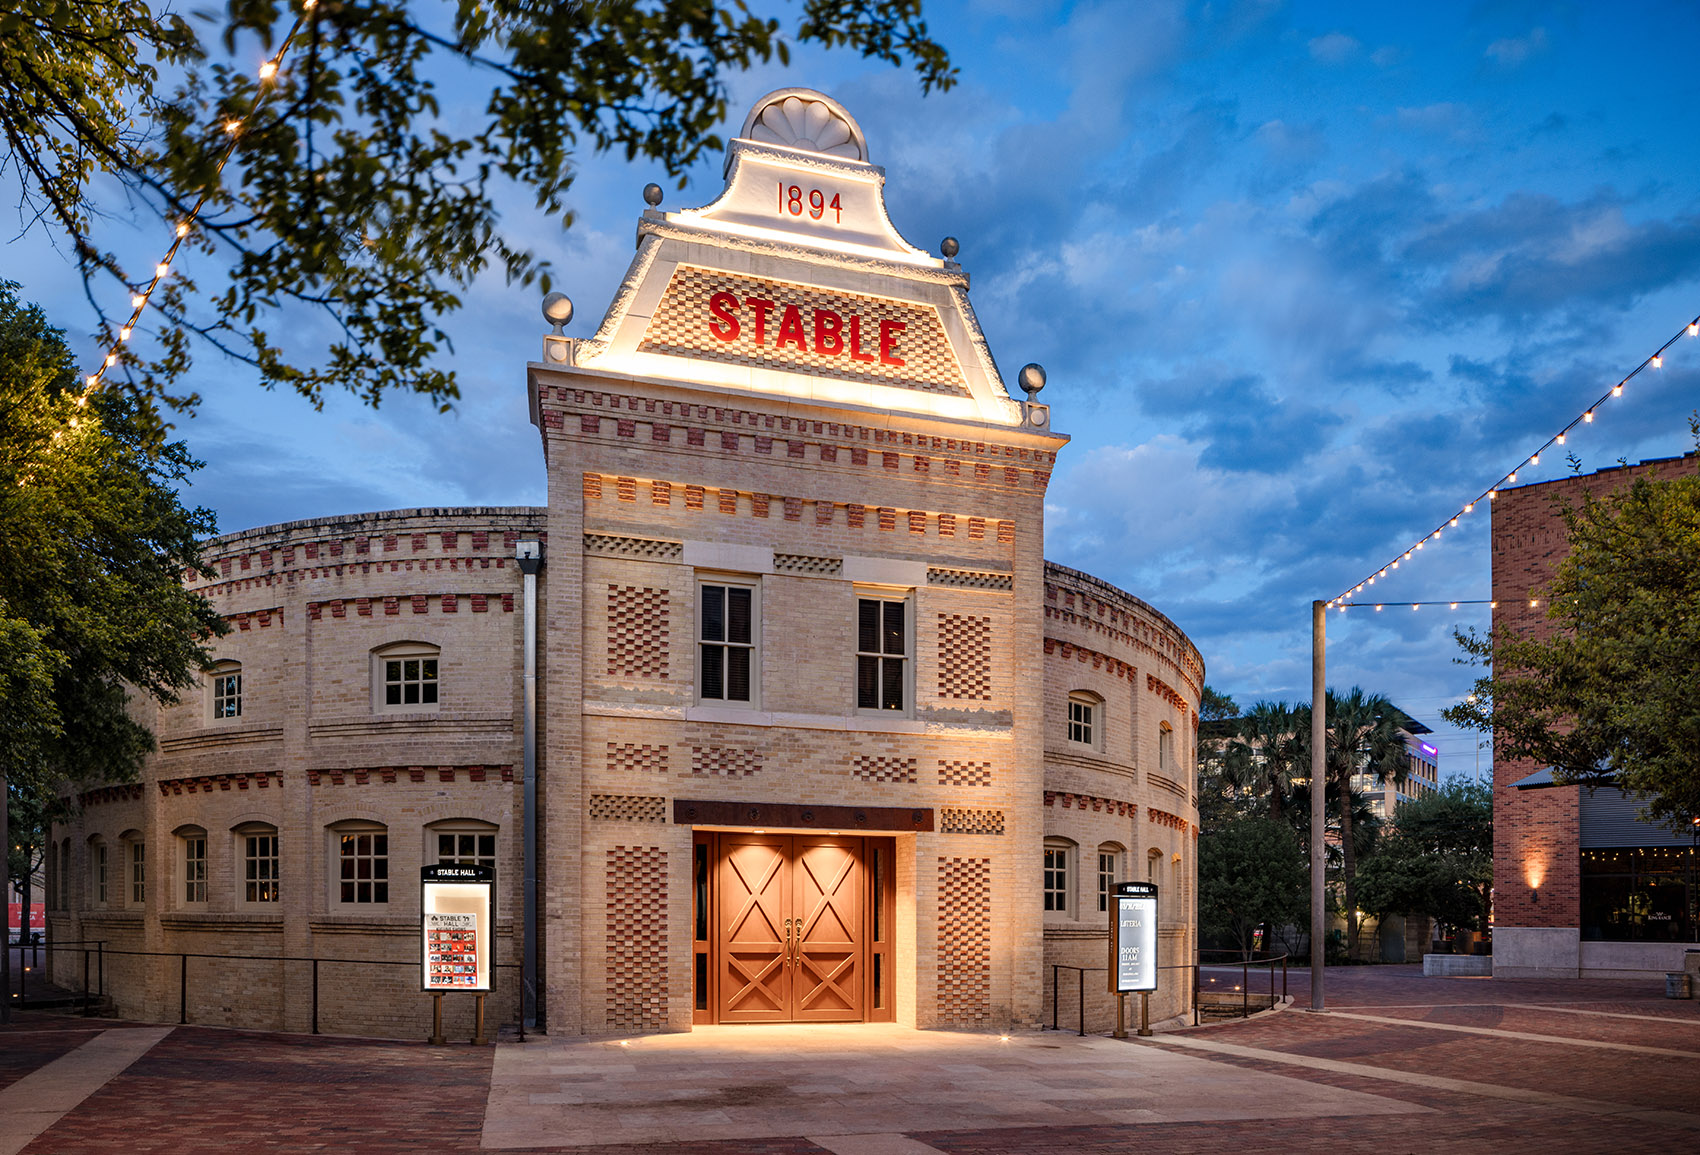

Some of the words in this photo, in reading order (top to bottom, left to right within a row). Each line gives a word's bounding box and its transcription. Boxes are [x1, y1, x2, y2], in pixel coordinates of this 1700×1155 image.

[778, 182, 843, 225] 1894
[708, 291, 906, 367] STABLE
[1120, 946, 1139, 954] DOORS
